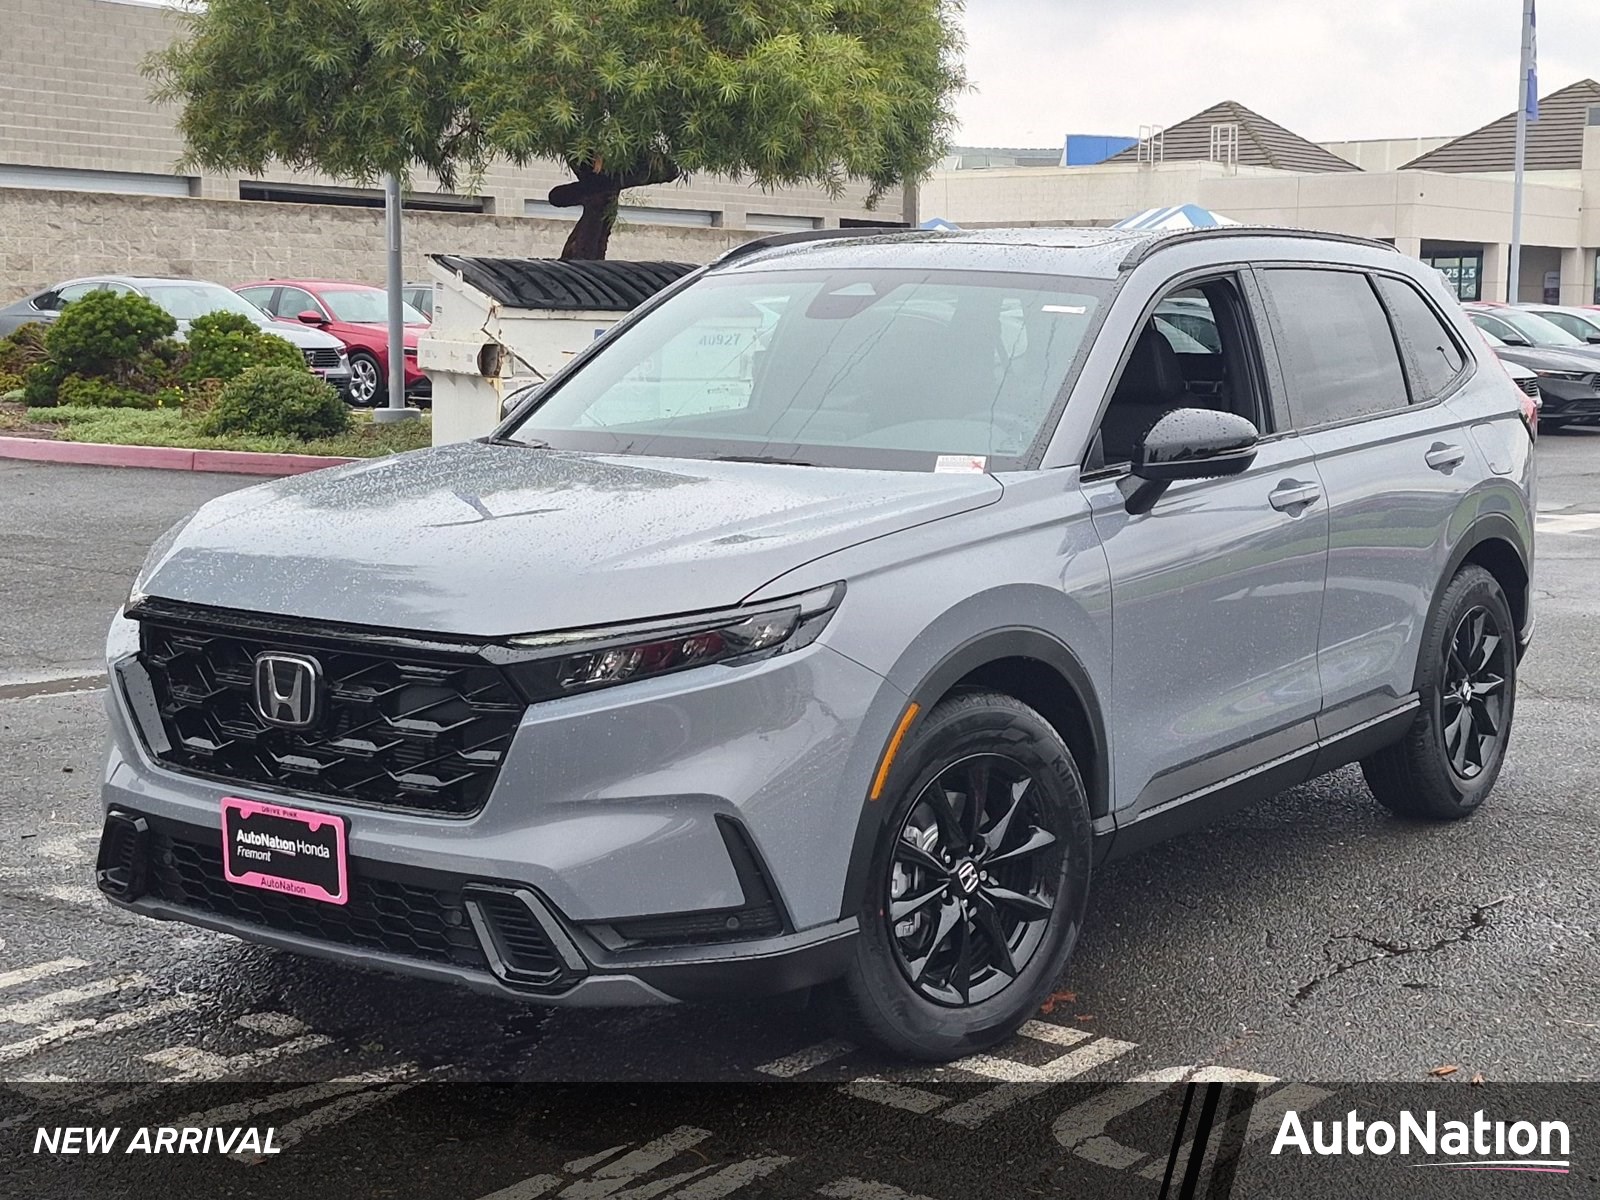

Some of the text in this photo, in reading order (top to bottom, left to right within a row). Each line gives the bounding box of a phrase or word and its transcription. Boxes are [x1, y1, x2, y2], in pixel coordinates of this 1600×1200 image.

[236, 829, 331, 859] AutoNation Honda
[236, 846, 271, 862] Fremont
[260, 877, 307, 895] AutoNation
